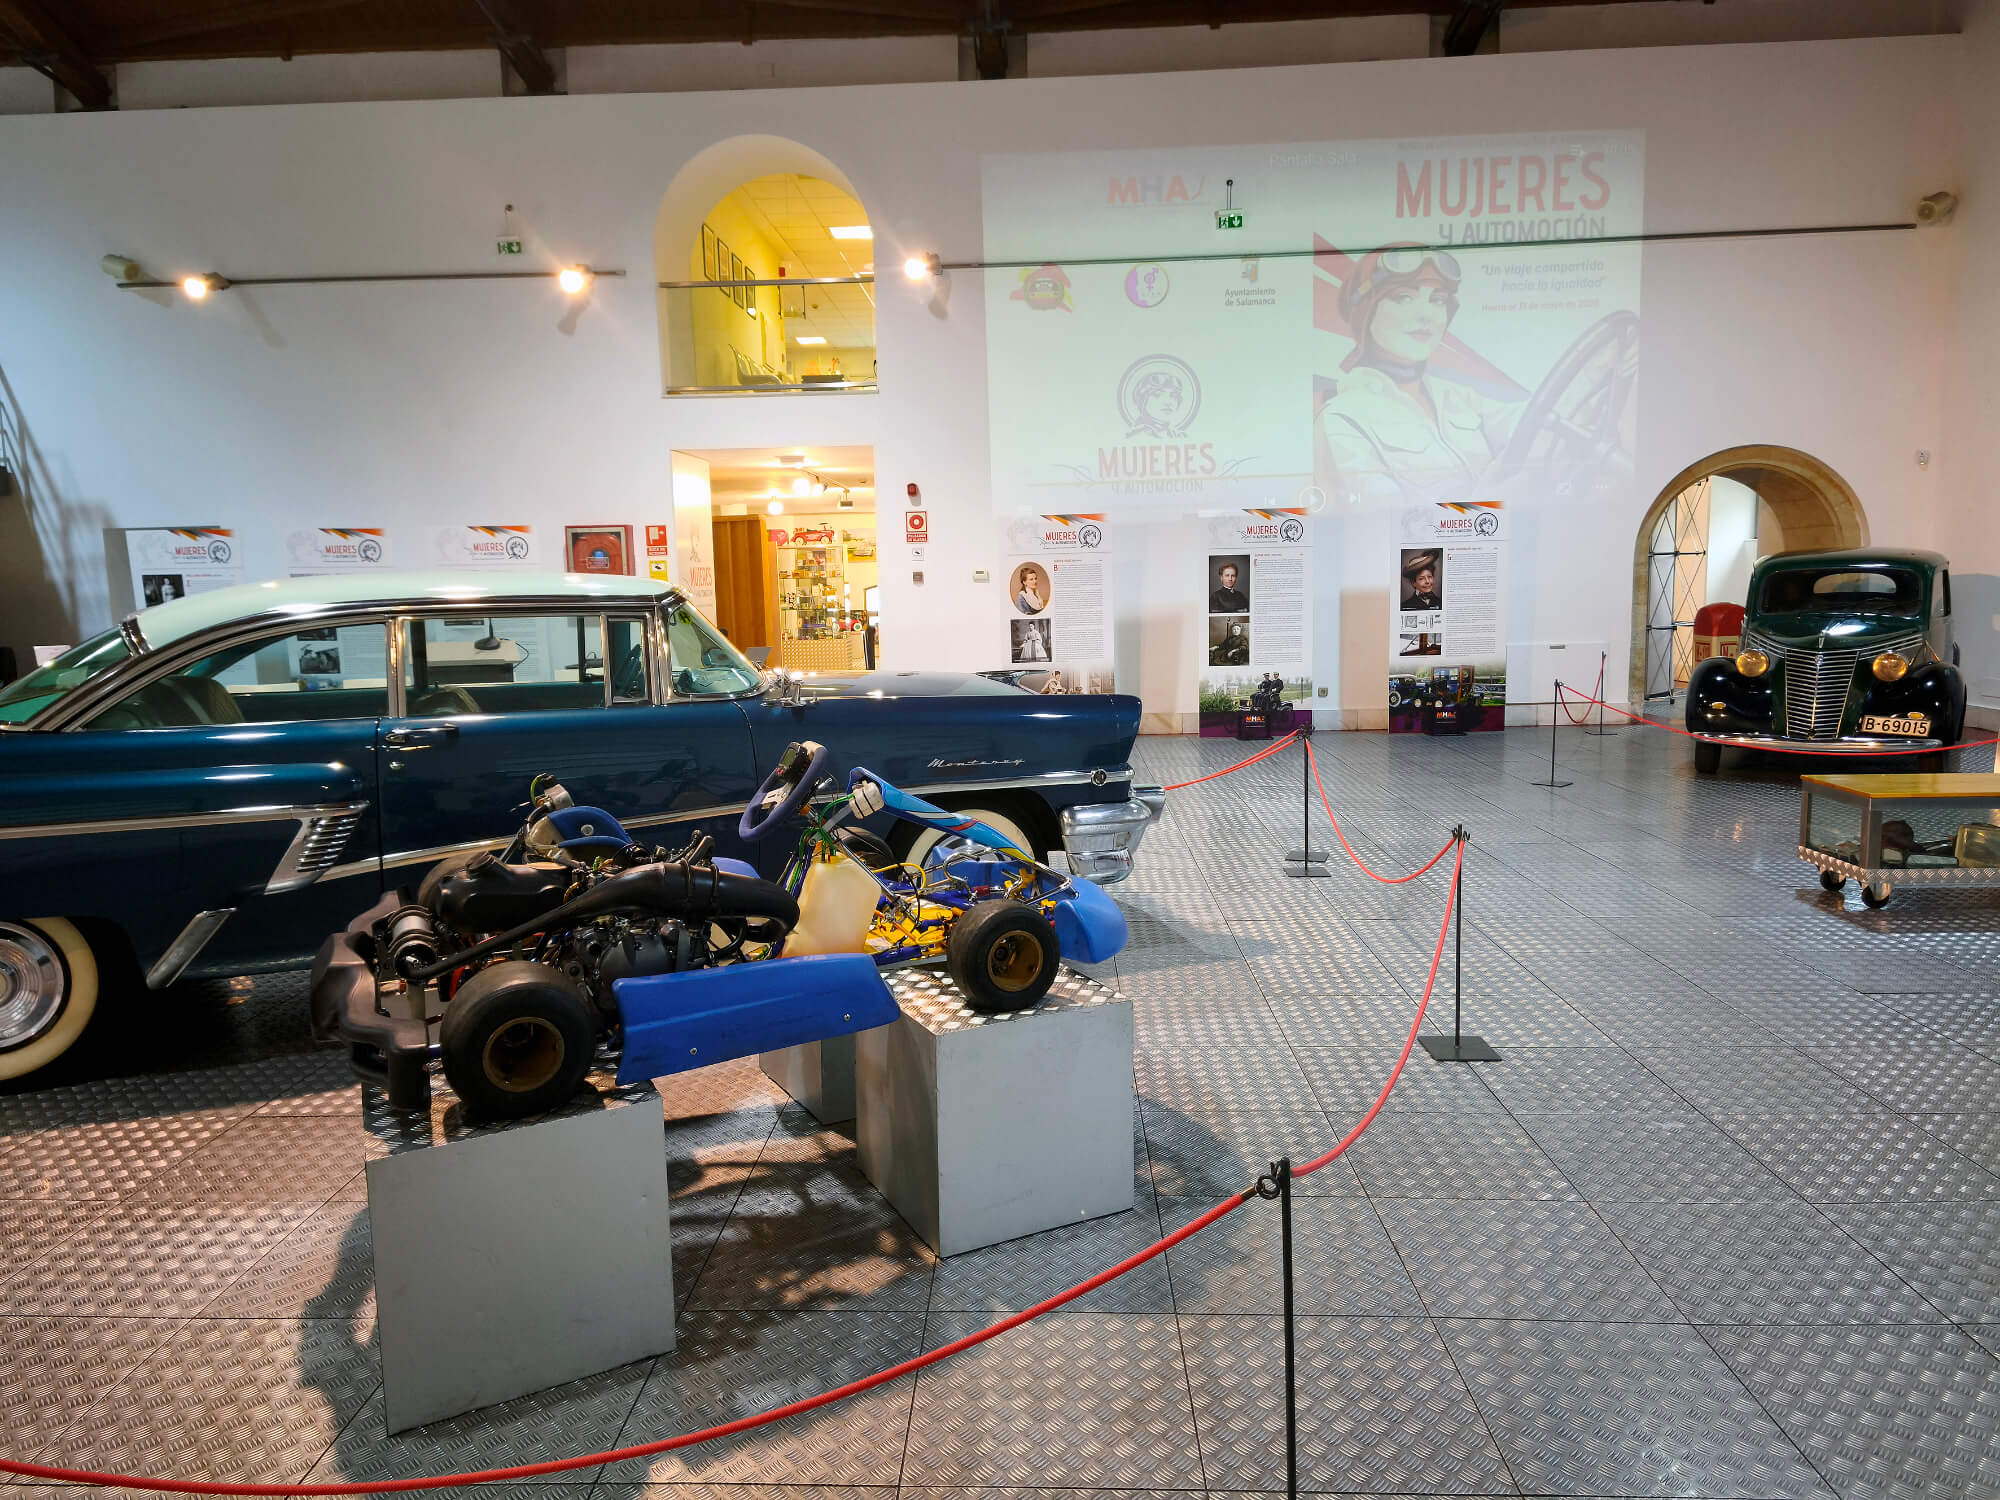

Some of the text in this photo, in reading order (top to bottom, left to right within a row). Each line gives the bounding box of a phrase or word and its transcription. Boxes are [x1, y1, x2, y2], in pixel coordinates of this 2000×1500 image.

[1395, 152, 1611, 219] MUJERES
[1461, 214, 1606, 246] AUTOMOCIÓN
[1504, 262, 1532, 279] viaje
[1224, 287, 1277, 298] Ayuntamiento
[1224, 297, 1277, 306] de Salamanca
[1098, 442, 1217, 479] MUJERES
[1441, 519, 1473, 529] MUJERES
[1045, 530, 1077, 541] MUJERES
[1246, 525, 1279, 535] MUJERES
[325, 544, 357, 554] MUJERES
[473, 542, 505, 552] MUJERES
[1865, 717, 1929, 735] B-69015
[927, 758, 1025, 769] Monterey
